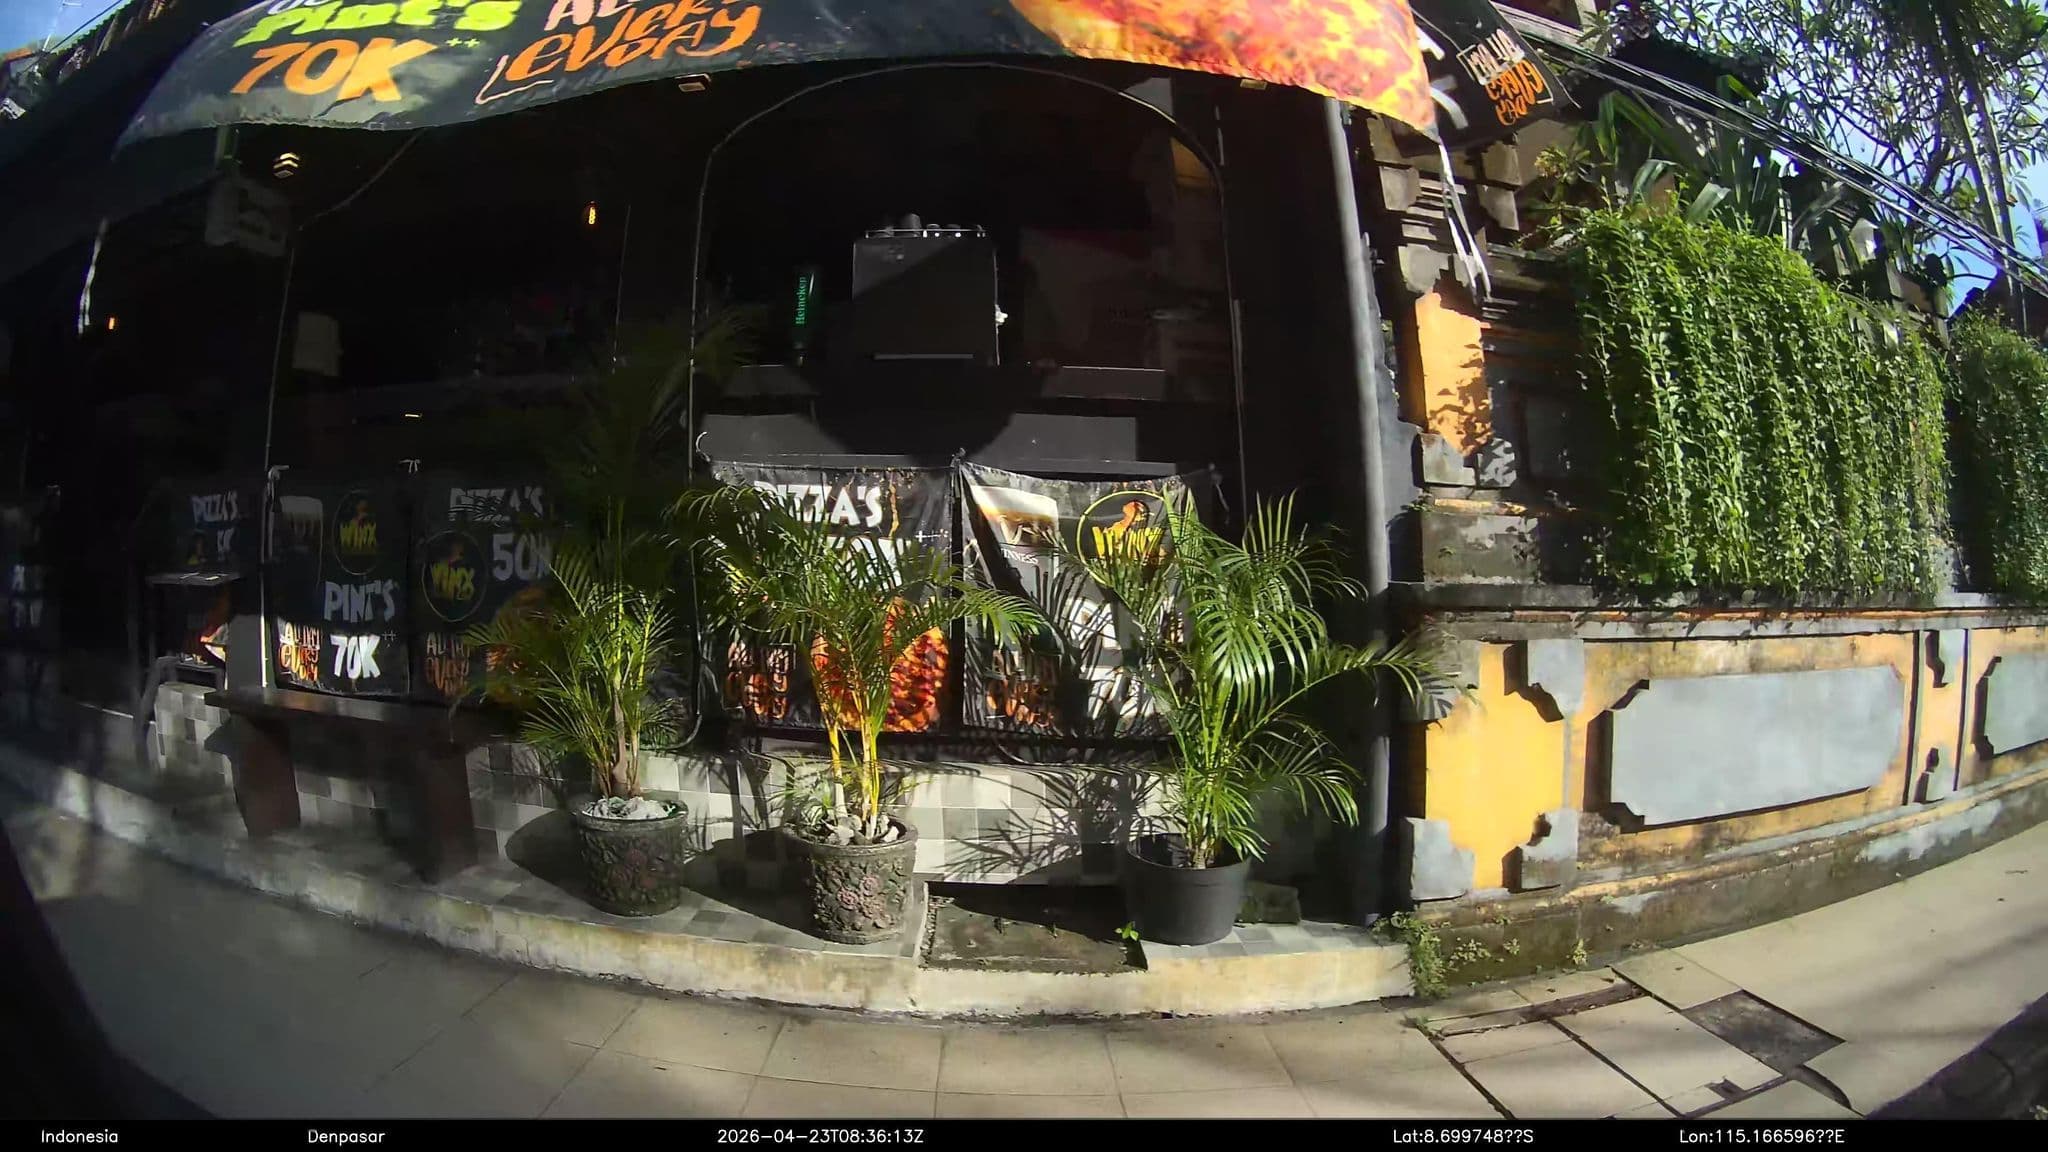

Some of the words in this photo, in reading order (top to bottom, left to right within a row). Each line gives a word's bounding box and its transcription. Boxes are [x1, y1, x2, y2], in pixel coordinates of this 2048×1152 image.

[231, 37, 438, 103] 70K
[323, 578, 398, 623] PINT'S
[329, 634, 381, 679] 70K
